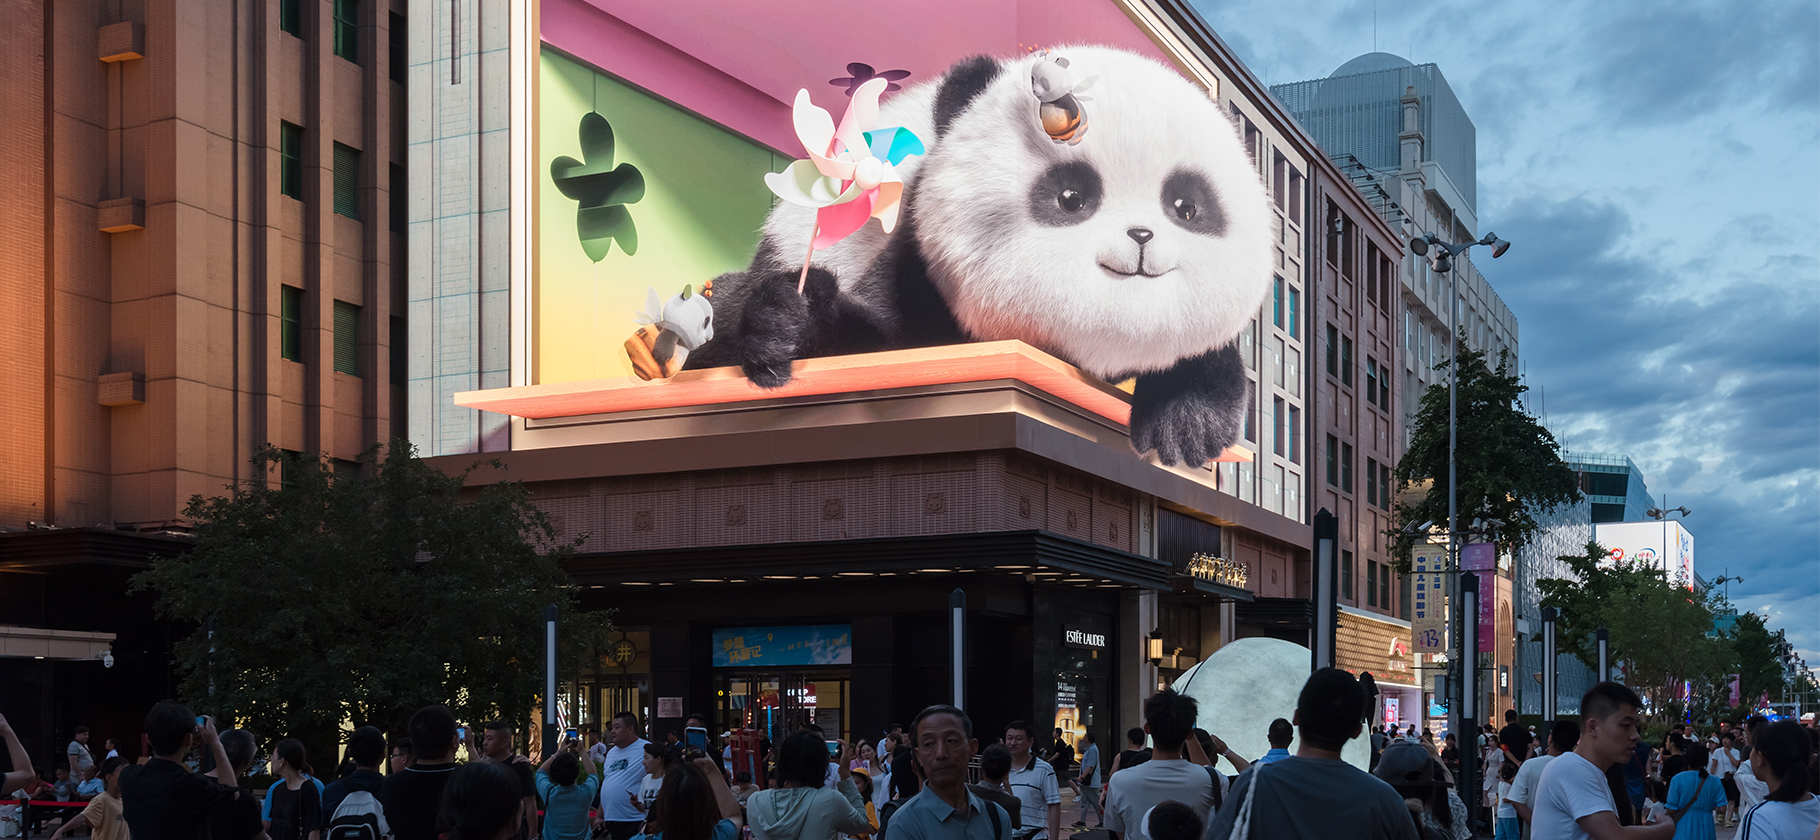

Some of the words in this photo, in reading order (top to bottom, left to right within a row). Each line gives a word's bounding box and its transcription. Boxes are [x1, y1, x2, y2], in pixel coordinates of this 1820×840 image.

[1416, 556, 1426, 619] 中国儿童戏剧节
[1083, 633, 1105, 647] LAUDER
[617, 644, 632, 662] 井
[797, 695, 817, 703] TORE
